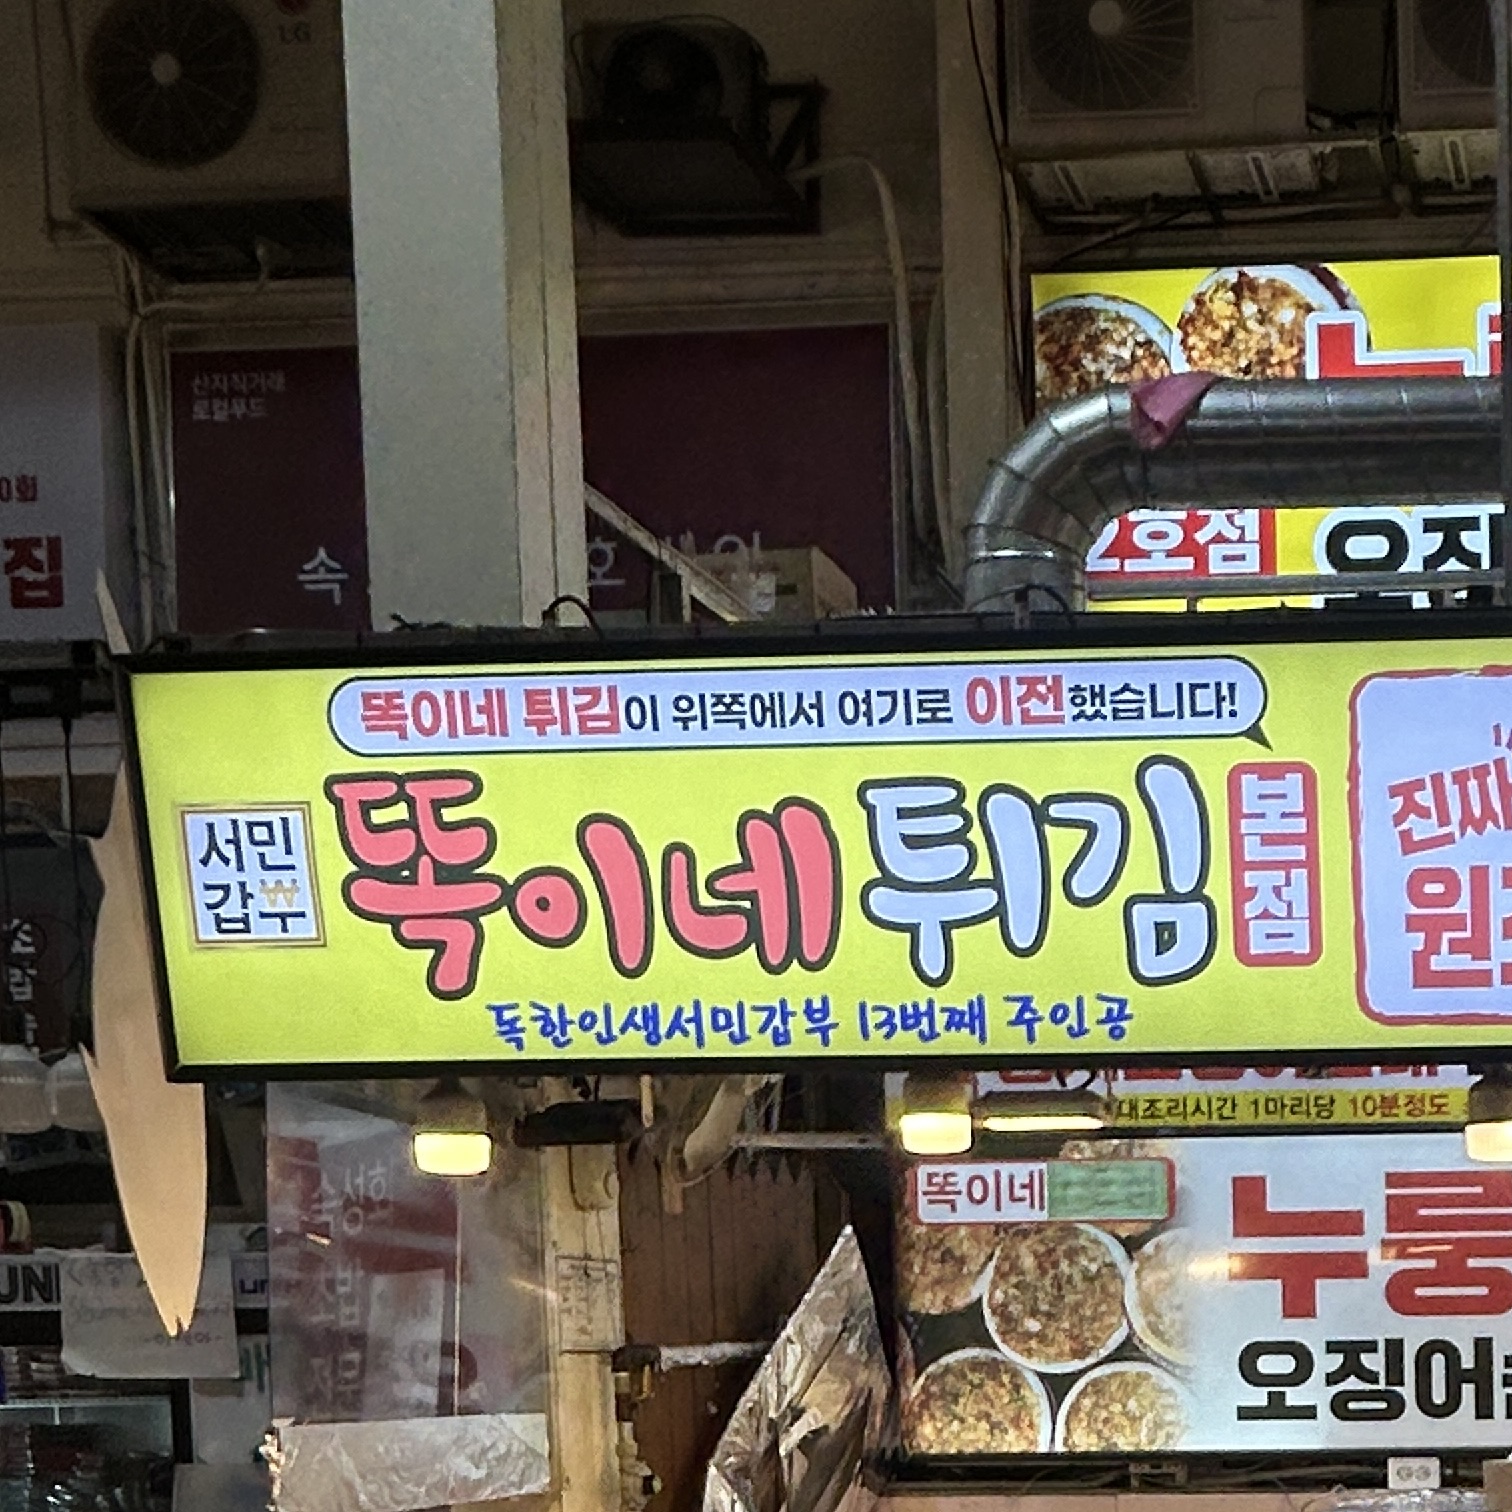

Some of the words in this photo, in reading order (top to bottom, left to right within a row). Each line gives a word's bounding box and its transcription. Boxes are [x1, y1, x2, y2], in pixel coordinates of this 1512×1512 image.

[360, 687, 510, 740] 똑이네
[672, 689, 826, 732] 위쪽에서
[838, 688, 953, 726] 여기로
[965, 674, 1239, 727] 이전했습니다!
[198, 816, 296, 873] 서민
[1238, 771, 1312, 958] 본점
[324, 768, 841, 999] 똑이네
[857, 754, 1213, 986] 튀김
[485, 994, 839, 1051] 독한인생서민갑부
[858, 999, 988, 1046] 13번째
[1003, 994, 1134, 1044] 주인공
[1249, 1095, 1336, 1120] 1마리당
[1349, 1091, 1450, 1118] 10분정도
[921, 1162, 1046, 1214] 똑이네
